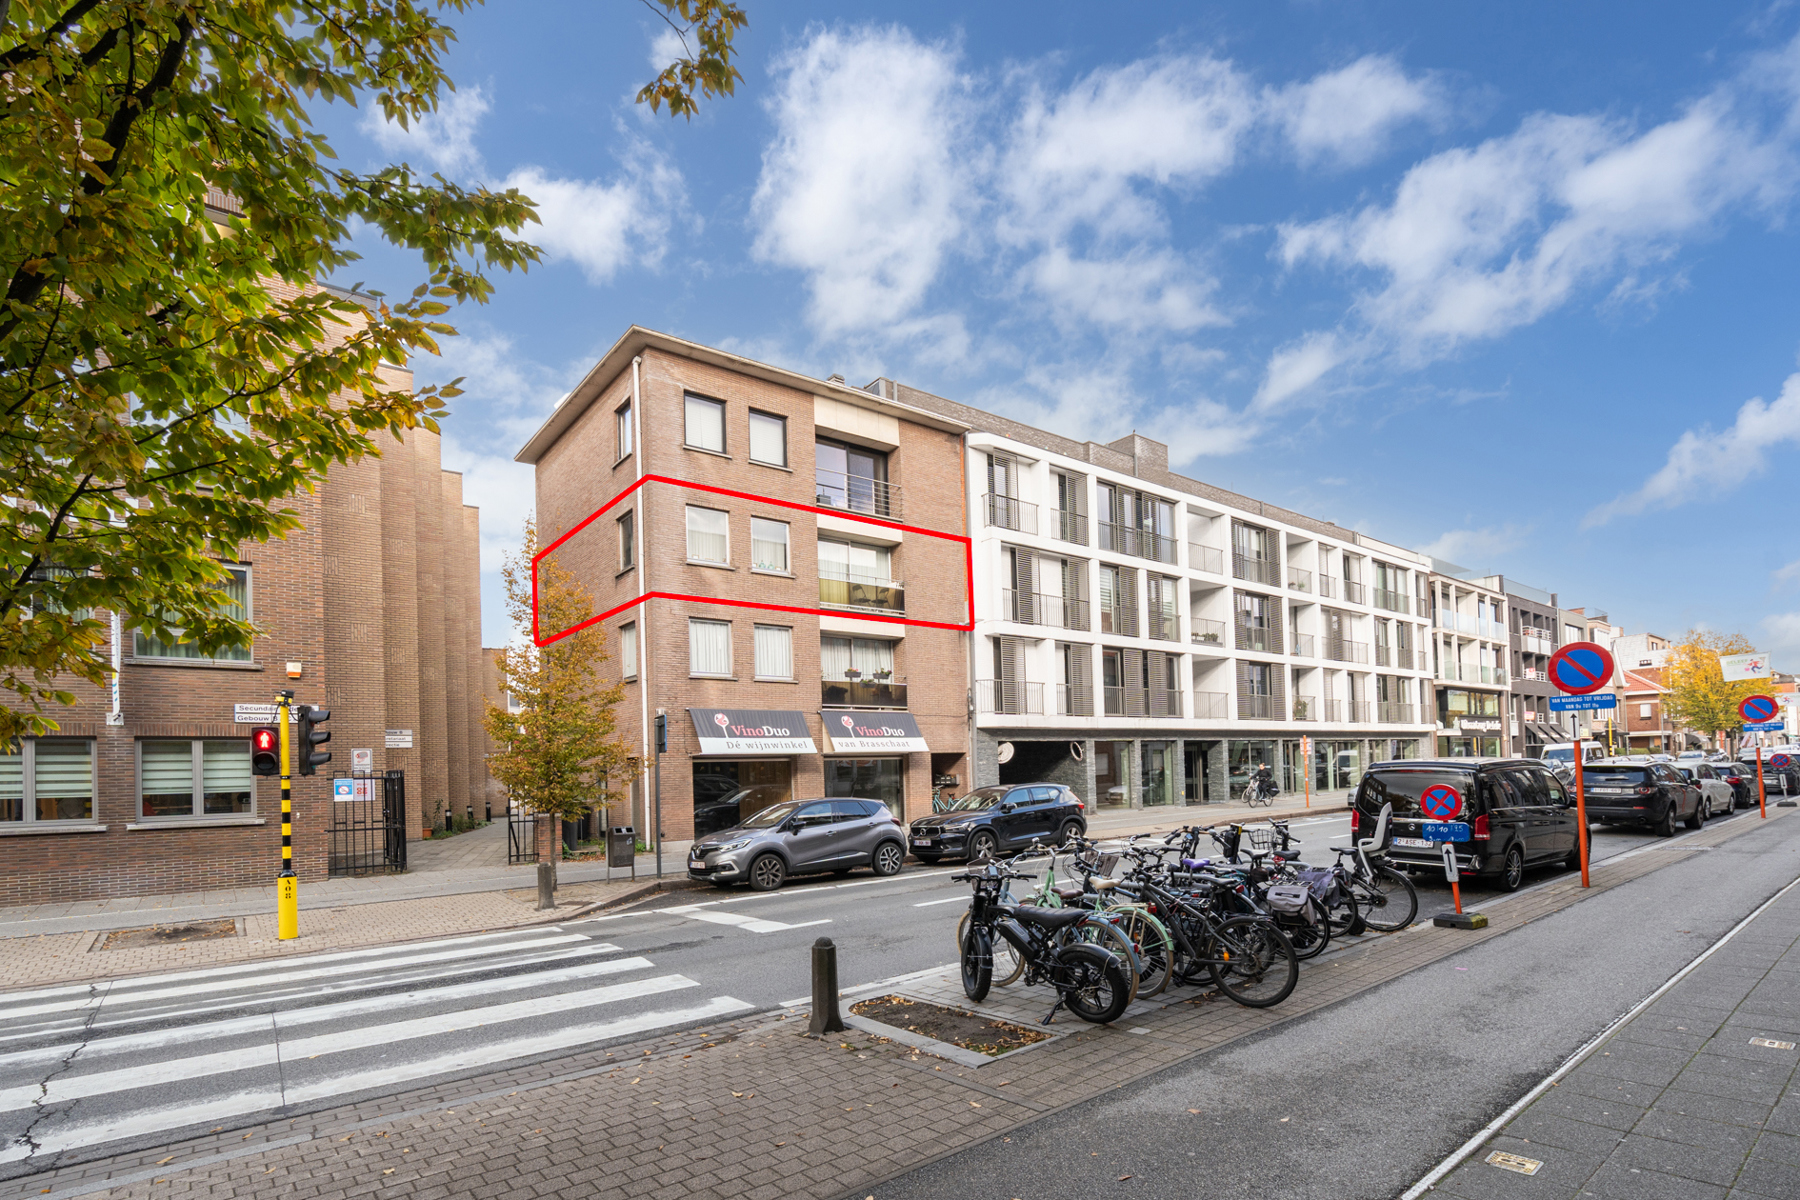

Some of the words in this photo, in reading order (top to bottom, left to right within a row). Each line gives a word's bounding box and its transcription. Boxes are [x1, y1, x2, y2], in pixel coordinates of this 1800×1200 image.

[730, 725, 790, 737] VinoDuo
[855, 726, 905, 737] VinoDuo
[726, 741, 741, 750] Dé
[745, 741, 808, 751] wijnwinkel
[859, 740, 910, 748] Brasschaat
